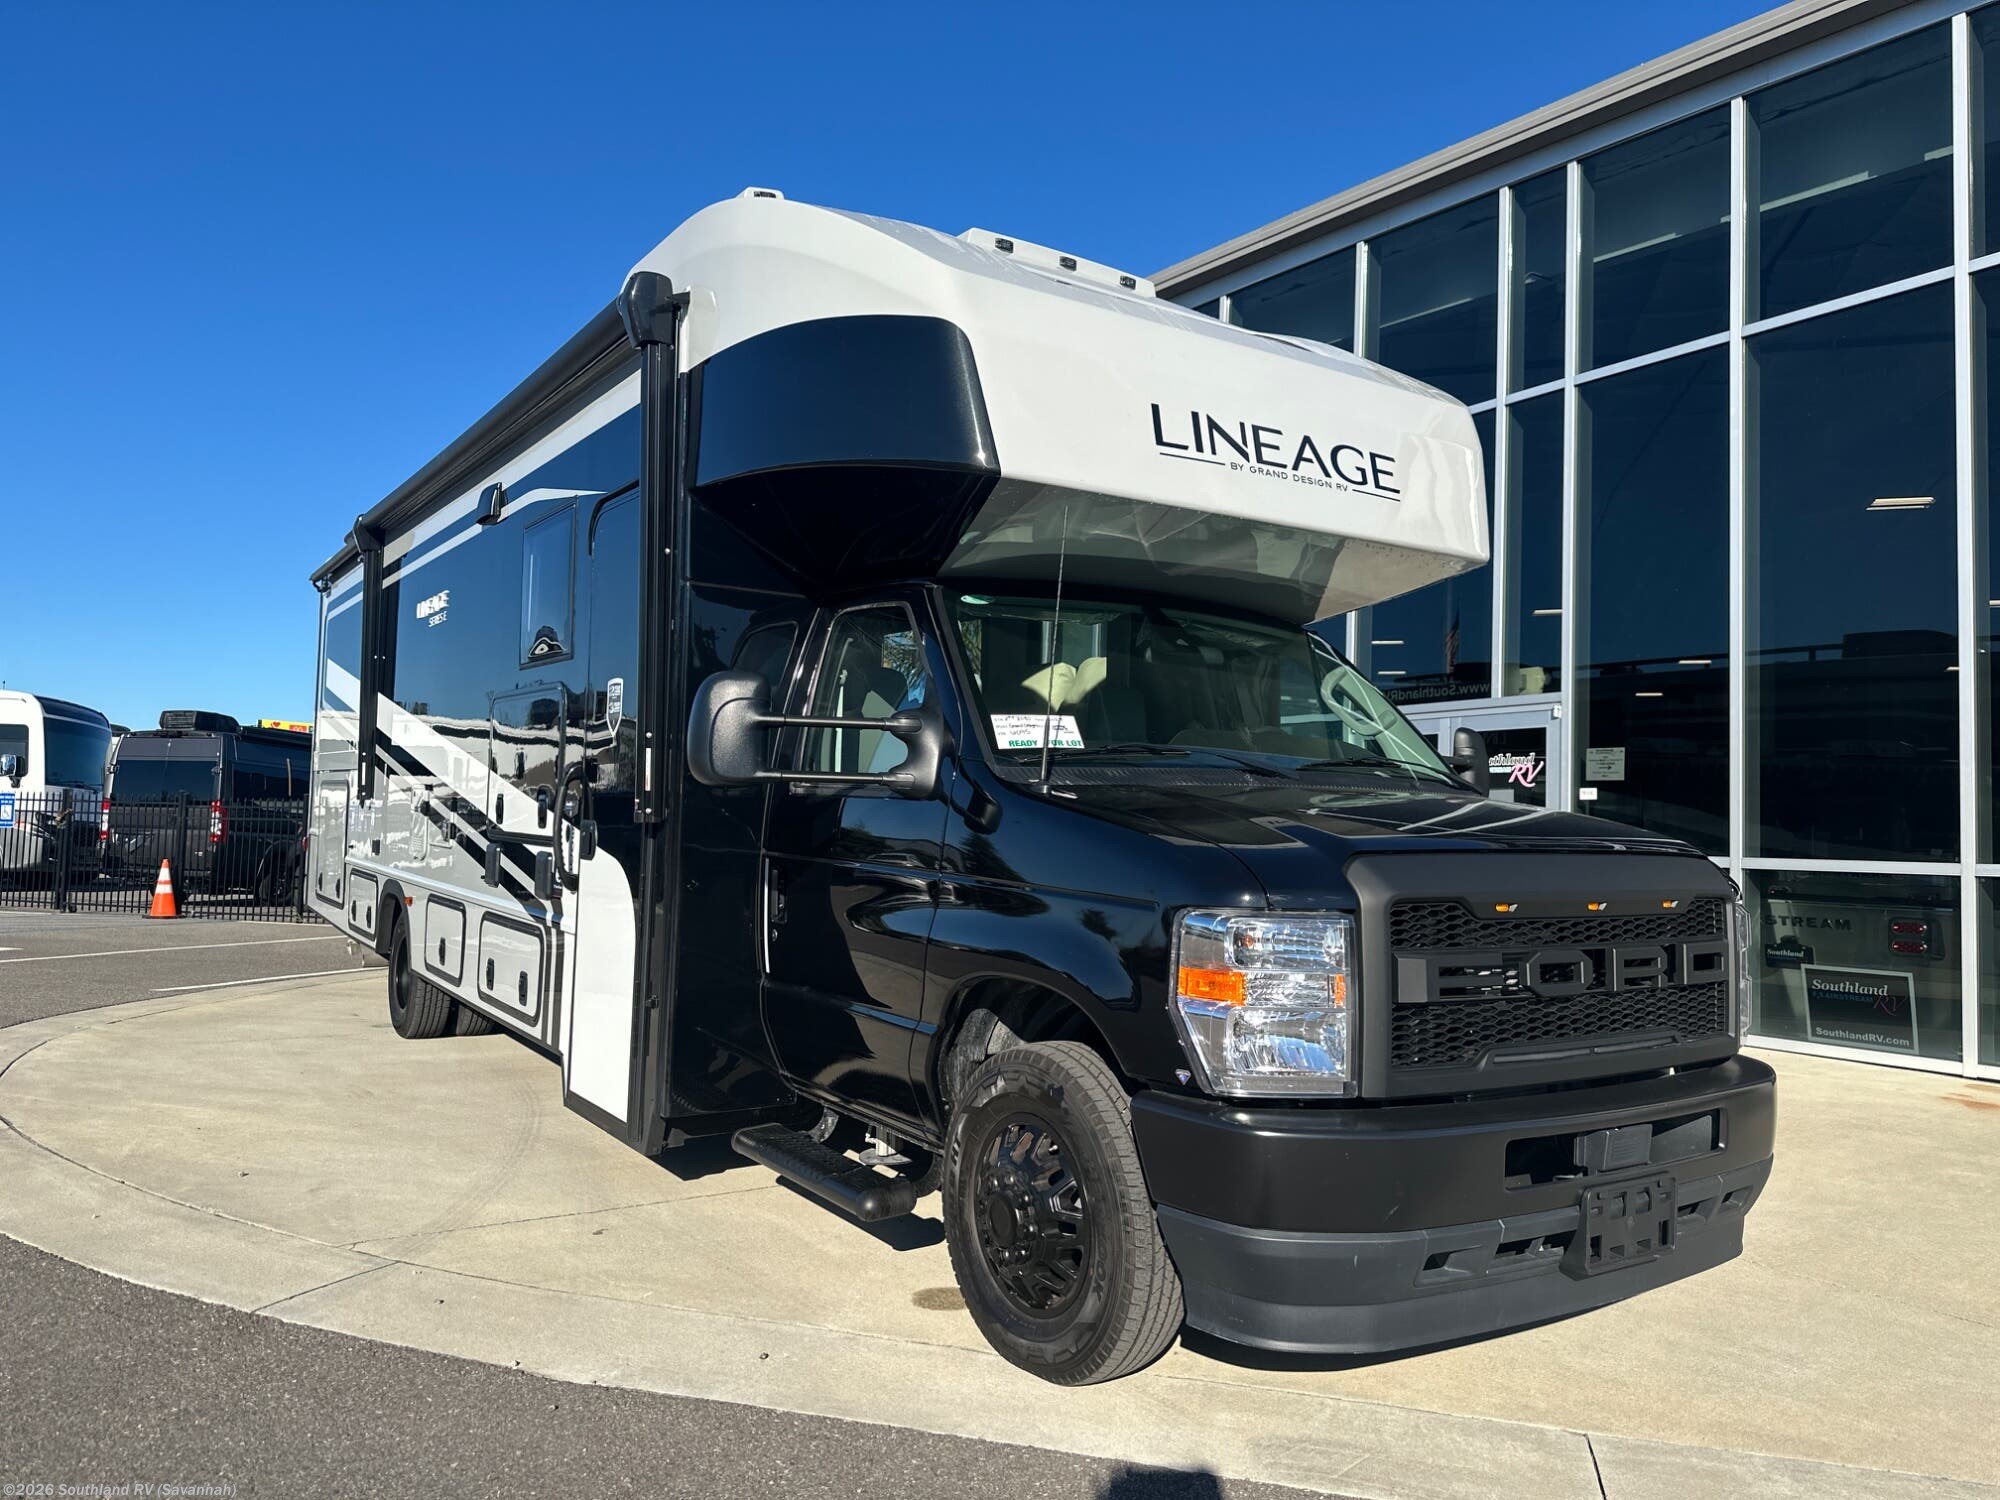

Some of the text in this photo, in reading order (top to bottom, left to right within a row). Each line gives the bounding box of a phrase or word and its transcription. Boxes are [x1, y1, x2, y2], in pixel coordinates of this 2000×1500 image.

[1150, 402, 1401, 495] LINEAGE
[1230, 462, 1349, 493] BY GRAND DESIGN RV
[1008, 739, 1038, 747] READY
[1066, 739, 1082, 747] LOT
[1508, 760, 1545, 788] RV
[1763, 914, 1852, 931] STREAM
[1394, 942, 1728, 1004] FORD
[1811, 978, 1889, 997] Southland
[1815, 1026, 1910, 1046] SouthlandRV.com
